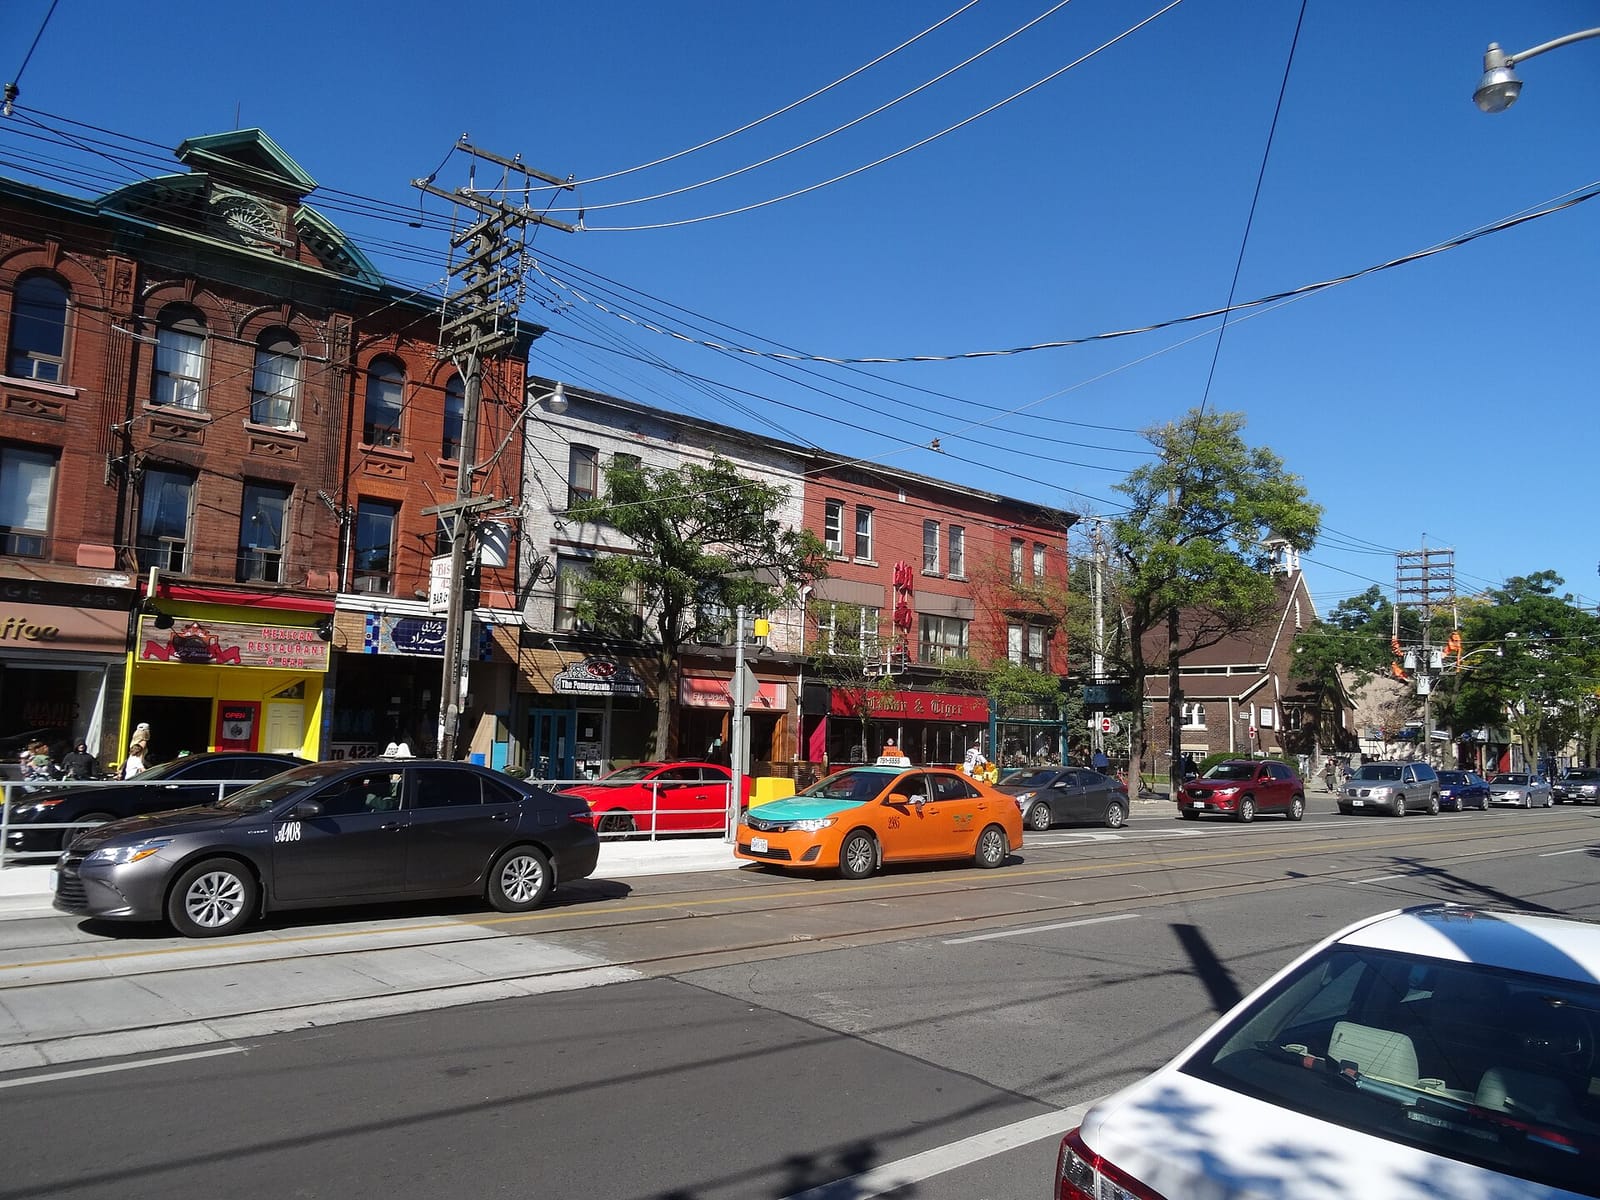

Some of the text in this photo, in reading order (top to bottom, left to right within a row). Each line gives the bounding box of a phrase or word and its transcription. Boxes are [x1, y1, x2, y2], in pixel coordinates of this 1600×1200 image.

[436, 563, 451, 576] Bis
[0, 616, 60, 641] ffee
[262, 628, 314, 642] MEXICAN
[247, 641, 325, 656] RESTAURANT
[267, 656, 304, 668] & BAR
[561, 680, 573, 689] The
[573, 681, 611, 691] Pomegranate
[914, 698, 925, 714] &
[930, 699, 963, 717] Tiger
[225, 711, 247, 719] OPEN
[349, 745, 376, 759] 422
[275, 821, 301, 842] A108
